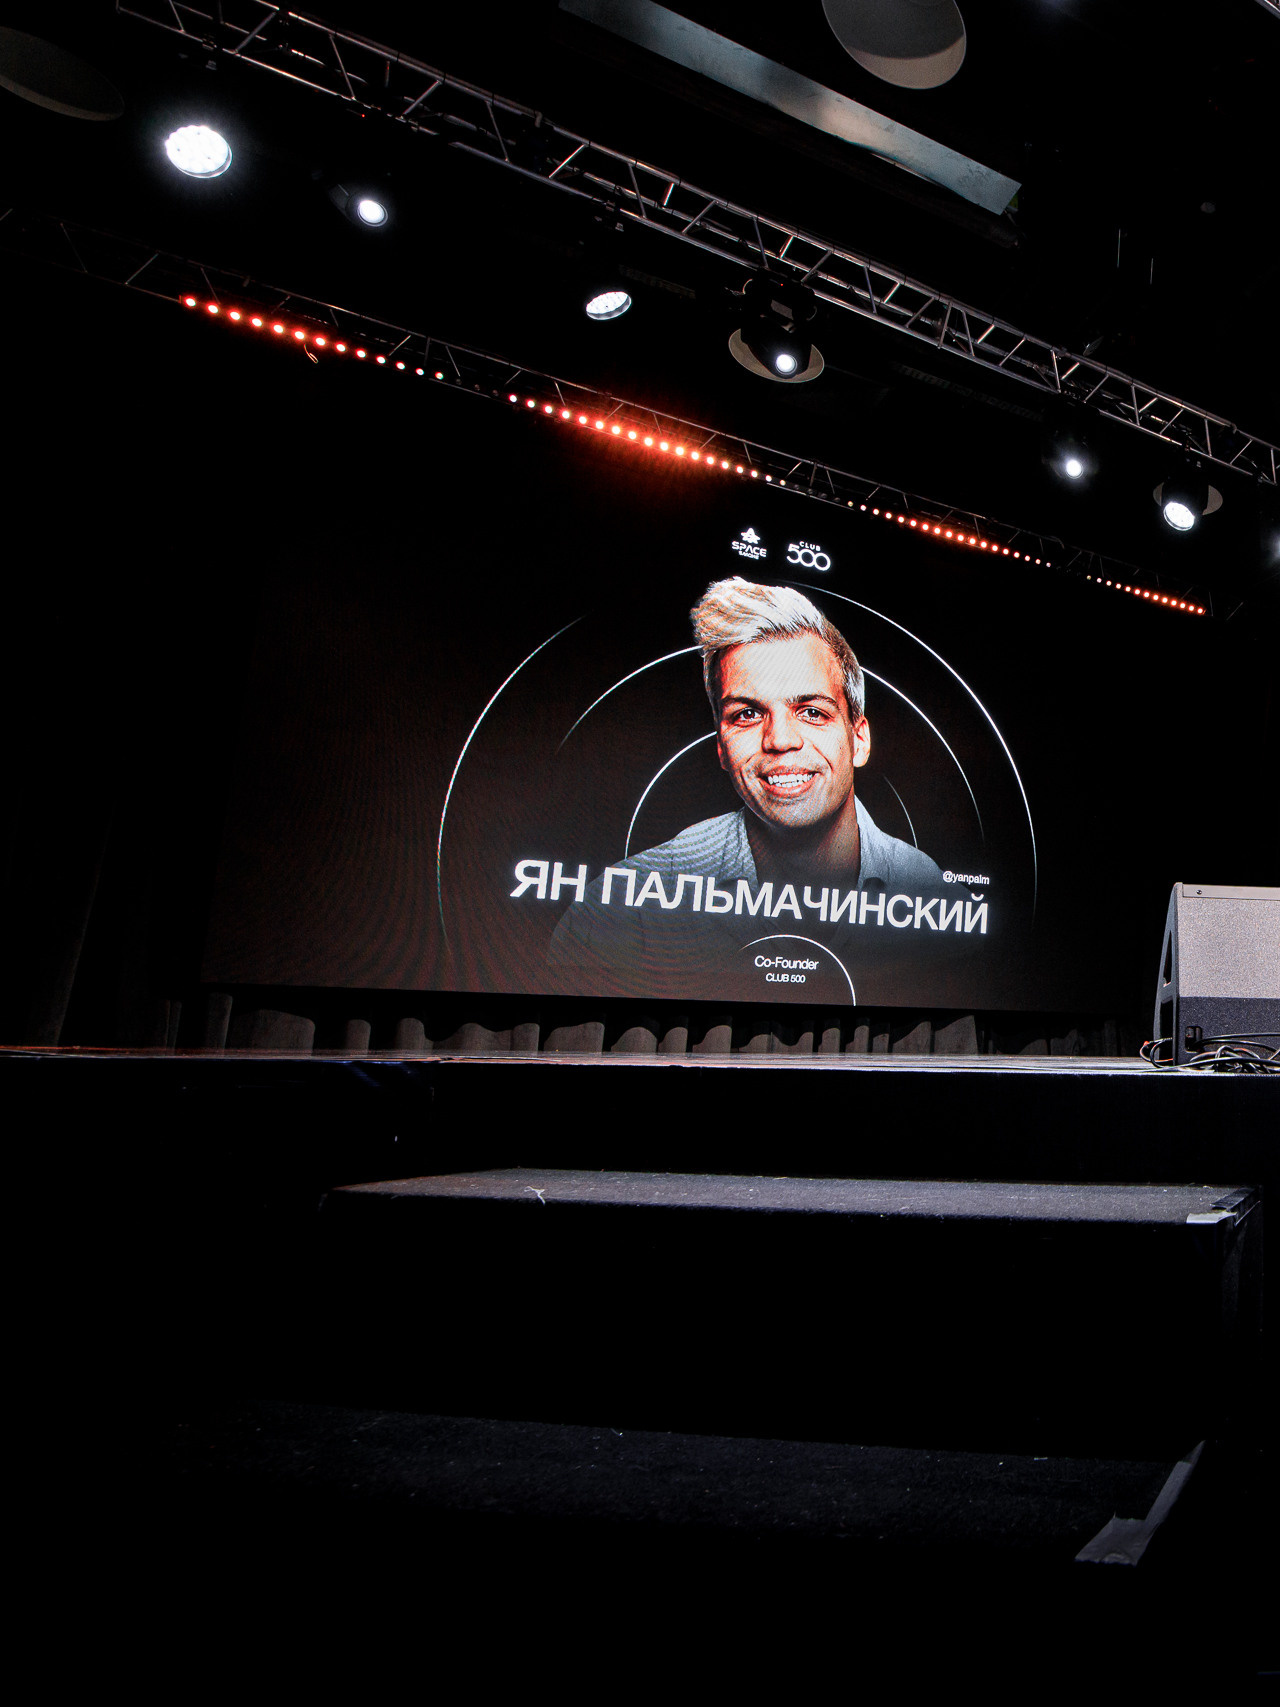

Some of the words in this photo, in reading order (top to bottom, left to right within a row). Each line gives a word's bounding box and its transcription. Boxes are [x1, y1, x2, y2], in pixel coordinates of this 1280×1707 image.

[731, 540, 767, 558] SPACE
[799, 540, 821, 552] CLUB
[786, 543, 832, 571] 500
[509, 858, 588, 902] ЯН
[601, 867, 989, 934] ПАЛЬМАЧИНСКИЙ
[754, 955, 819, 970] Co-Founder
[765, 972, 790, 982] CLUB
[790, 974, 806, 983] 500
